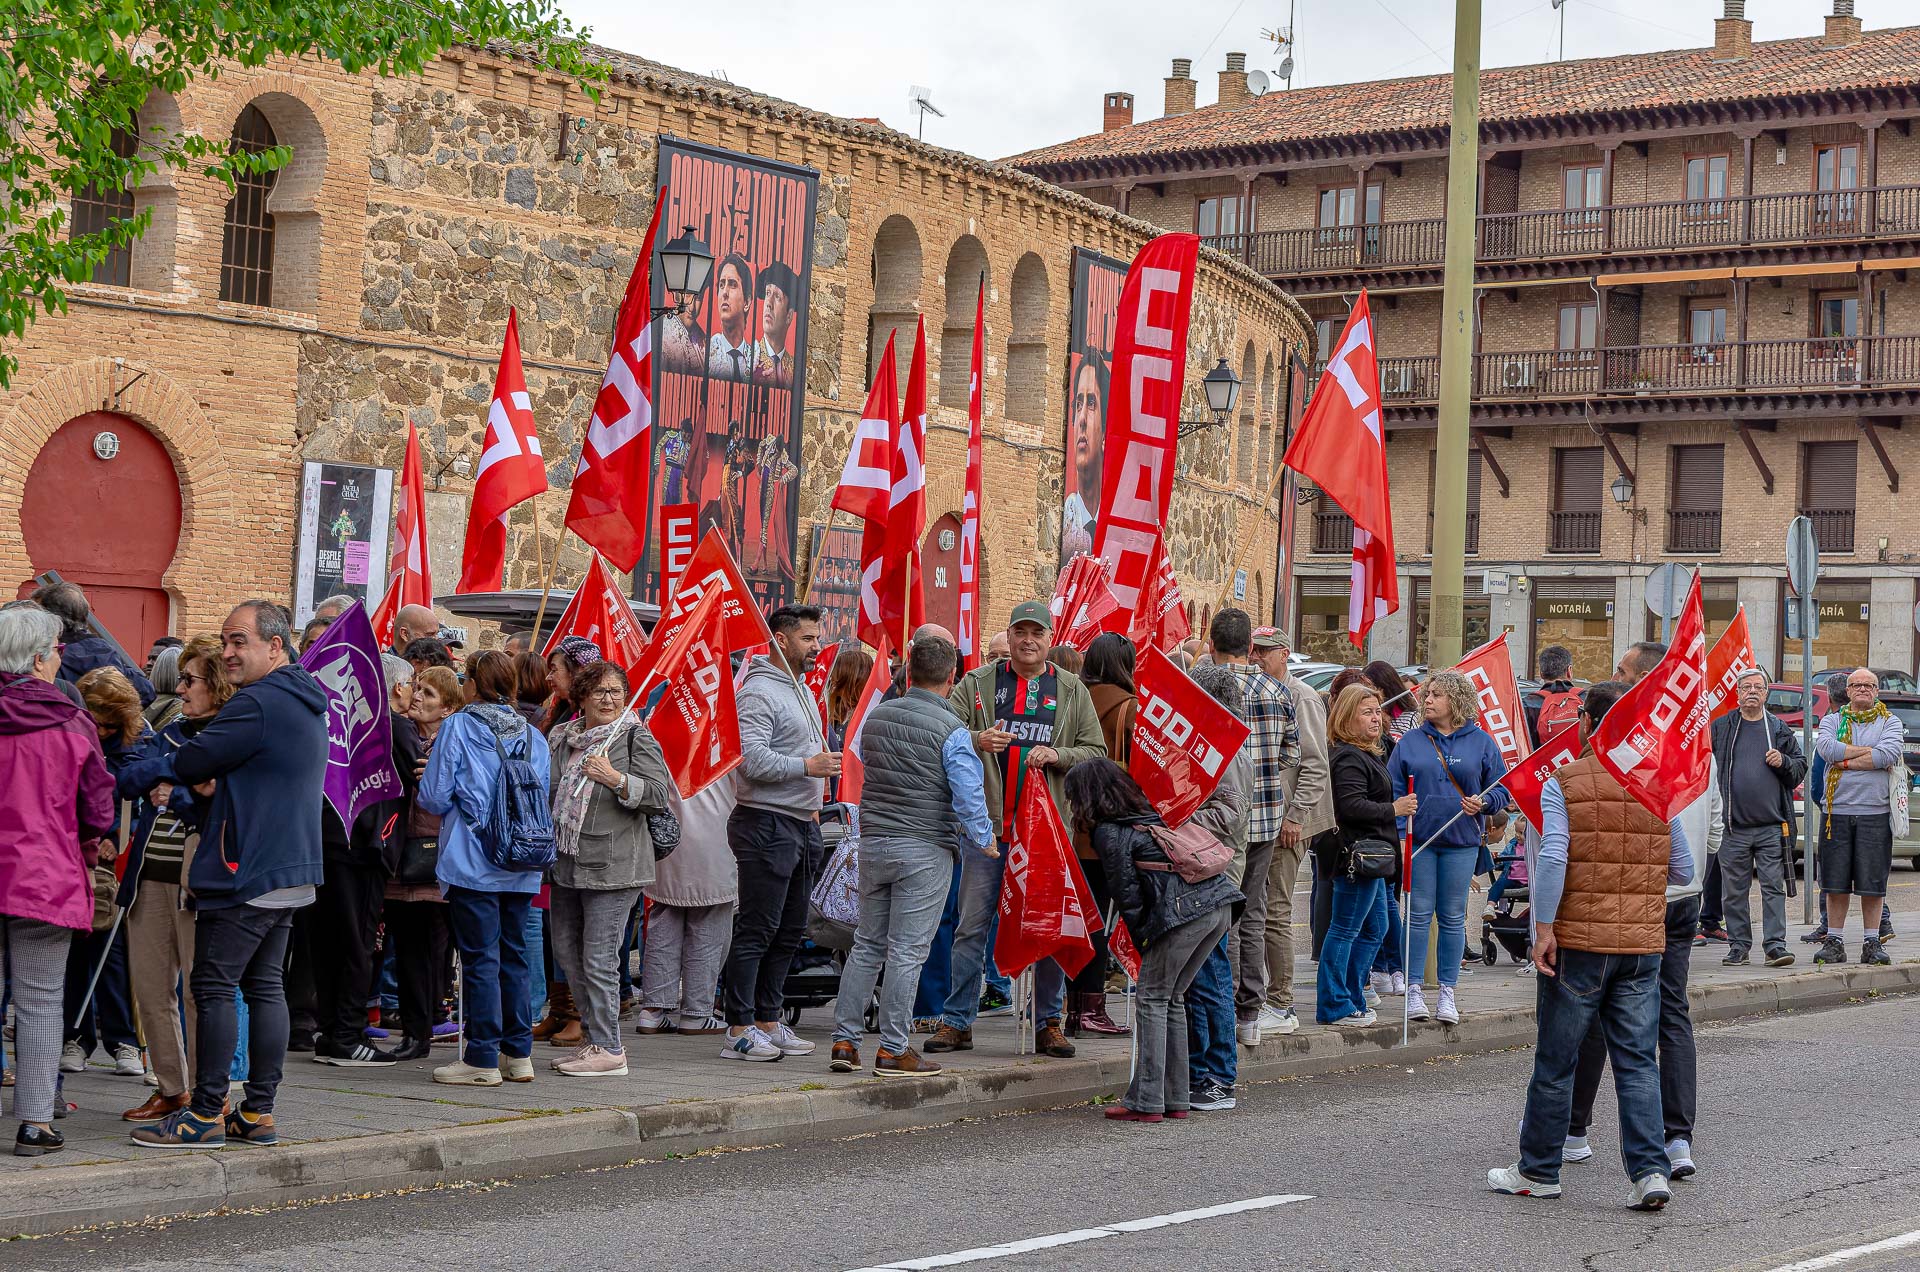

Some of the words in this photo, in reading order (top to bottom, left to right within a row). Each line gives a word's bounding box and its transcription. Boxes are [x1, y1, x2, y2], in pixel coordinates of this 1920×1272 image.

[318, 560, 325, 568] DE
[320, 550, 341, 560] DESFILE
[935, 567, 948, 588] SOL
[1549, 602, 1591, 614] NOTARÍA
[1819, 604, 1844, 616] ARÍA
[681, 684, 702, 719] obreras
[1464, 666, 1517, 753] CCOO
[676, 696, 699, 733] Mancha
[1138, 726, 1166, 754] Obreras
[1140, 740, 1167, 768] Mancha
[1534, 770, 1544, 782] de
